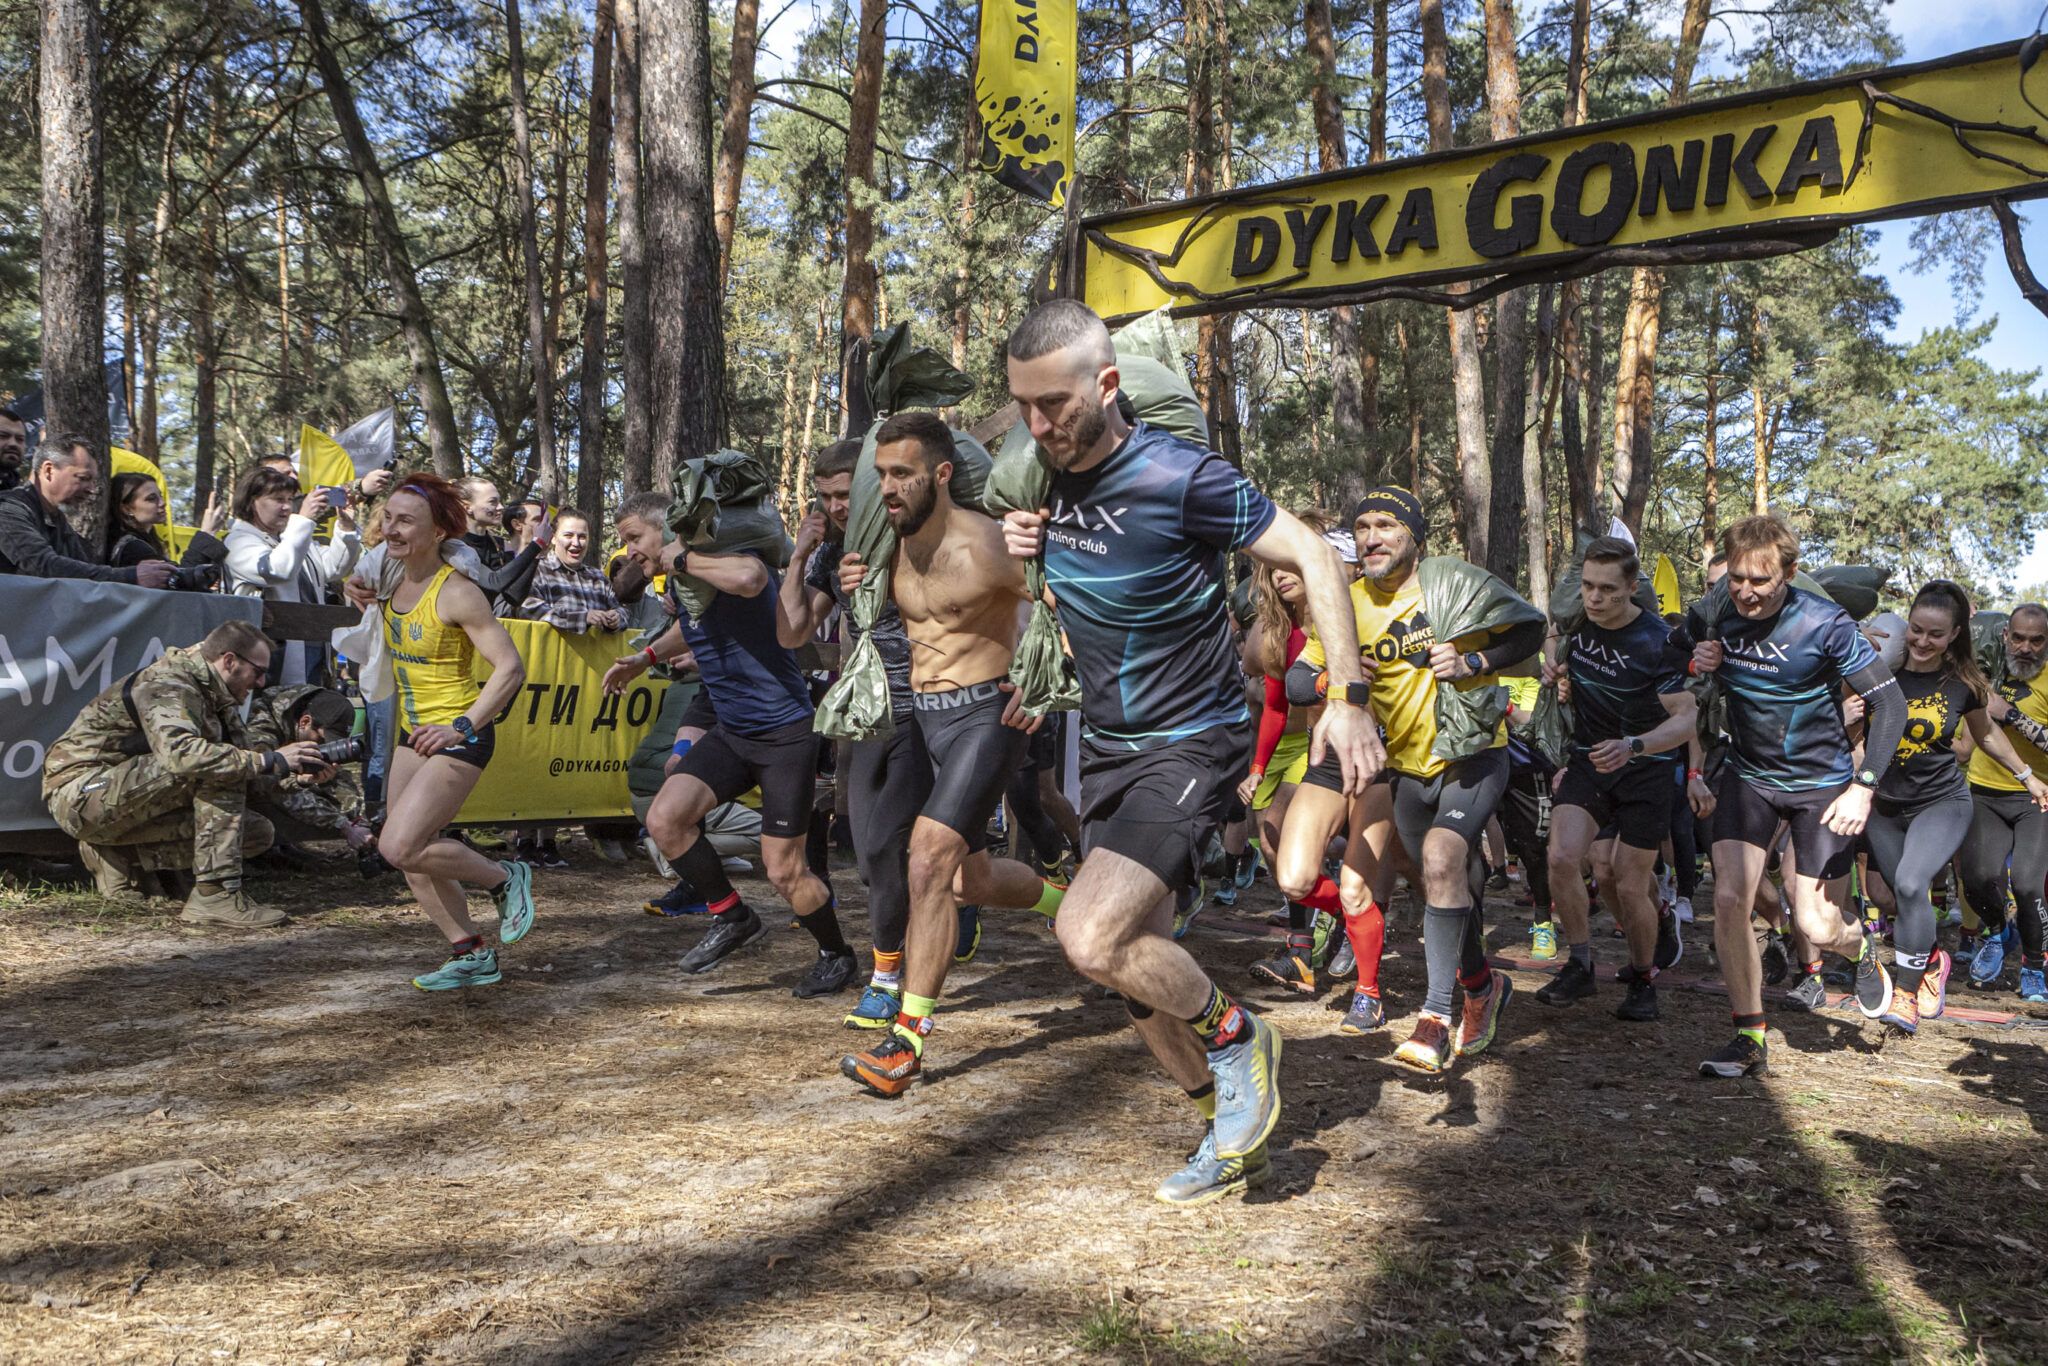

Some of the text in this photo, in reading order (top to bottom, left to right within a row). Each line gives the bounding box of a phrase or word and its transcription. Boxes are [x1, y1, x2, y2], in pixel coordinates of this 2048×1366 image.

[1014, 0, 1040, 63] DY
[1231, 115, 1845, 278] DYKA GONKA
[1367, 491, 1411, 513] GONKA
[1079, 538, 1108, 555] club
[1571, 632, 1631, 670] AJAX
[1571, 650, 1617, 678] Running club
[1759, 661, 1779, 673] club
[477, 681, 580, 726] УТИ
[549, 757, 630, 777] @DYKAGON
